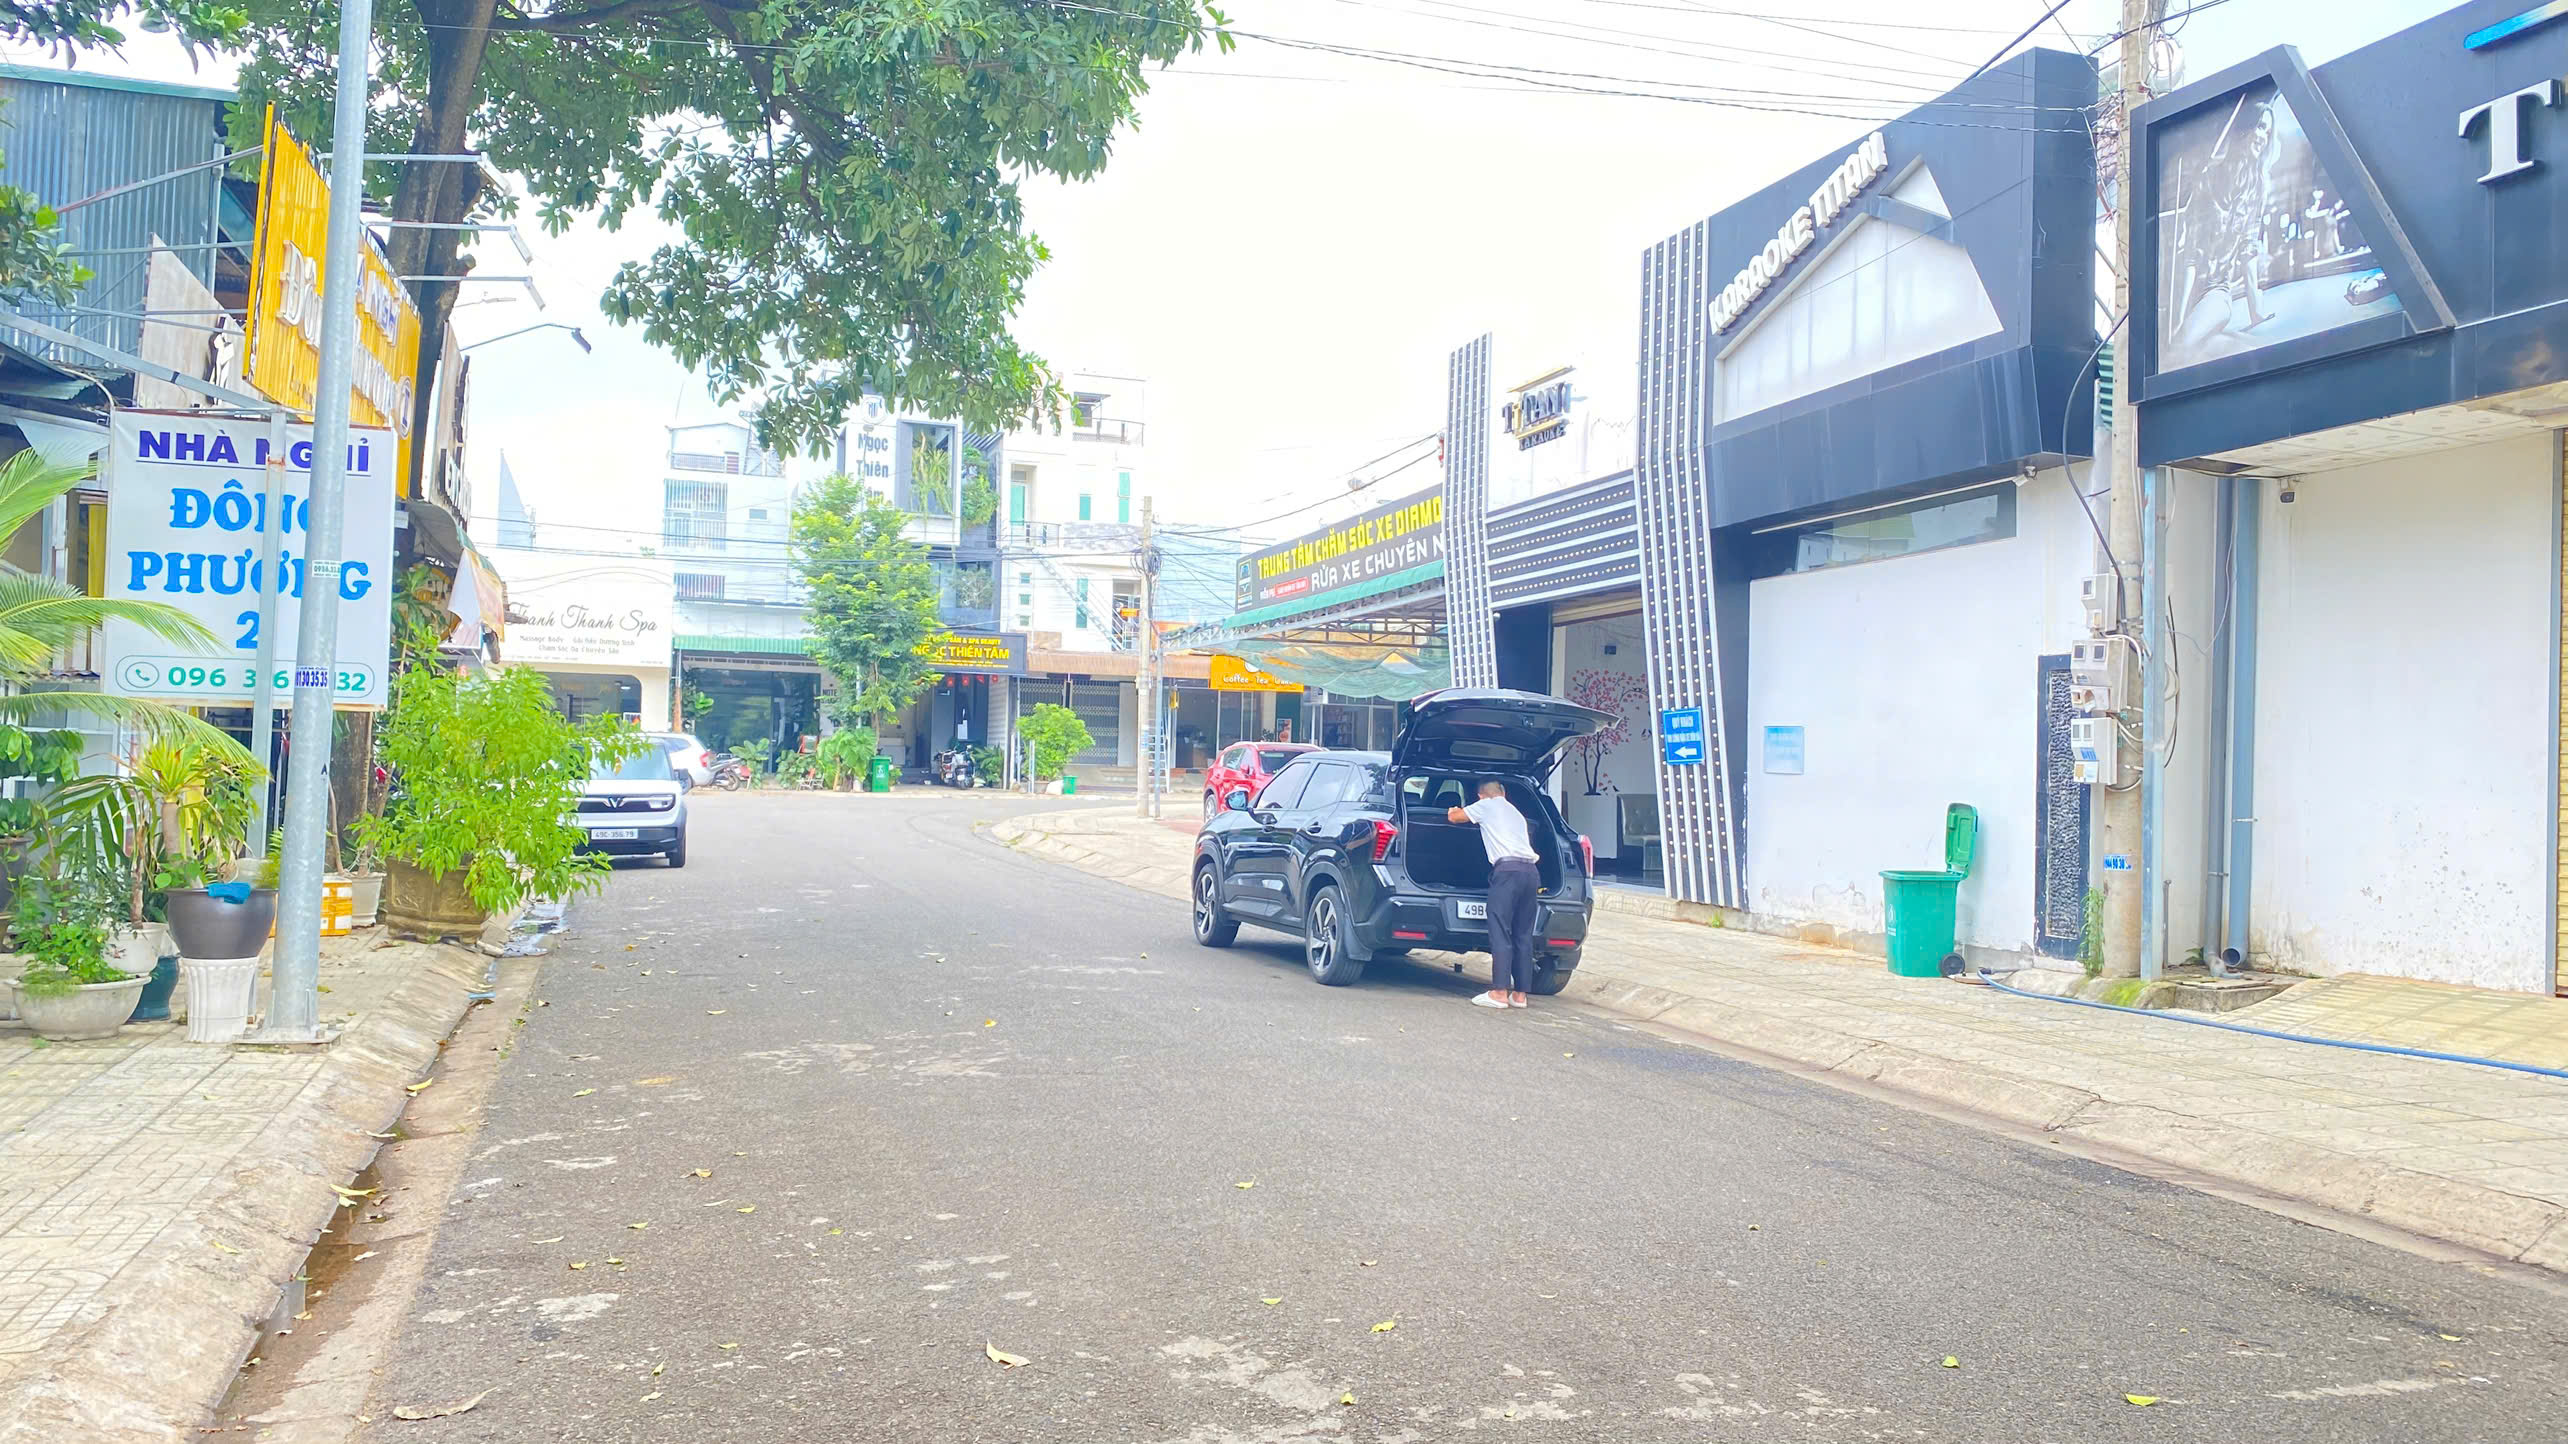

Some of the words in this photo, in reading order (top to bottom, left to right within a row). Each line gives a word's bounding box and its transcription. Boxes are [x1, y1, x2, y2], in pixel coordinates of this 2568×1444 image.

[1708, 206, 1815, 335] KARAOKE
[1808, 131, 1888, 229] TITAN
[139, 430, 239, 464] NHÀ
[256, 438, 370, 472] NGỈ
[858, 433, 889, 453] Ngọc
[1519, 422, 1566, 451] KARAOKE
[856, 460, 889, 478] Thiên
[1257, 552, 1290, 580] TRUNG
[1291, 540, 1314, 570] TÂM
[1315, 527, 1346, 563] CHĂM
[1348, 517, 1374, 552] SÓC
[1375, 513, 1394, 544] XE
[1311, 562, 1338, 592] RỬA
[1341, 559, 1361, 585] XE
[1365, 538, 1428, 576] CHUYÊN
[561, 605, 614, 629] Thanh
[619, 610, 657, 637] Spa
[981, 646, 1010, 659] TÂM
[168, 666, 226, 688] 096
[242, 667, 290, 690] 36
